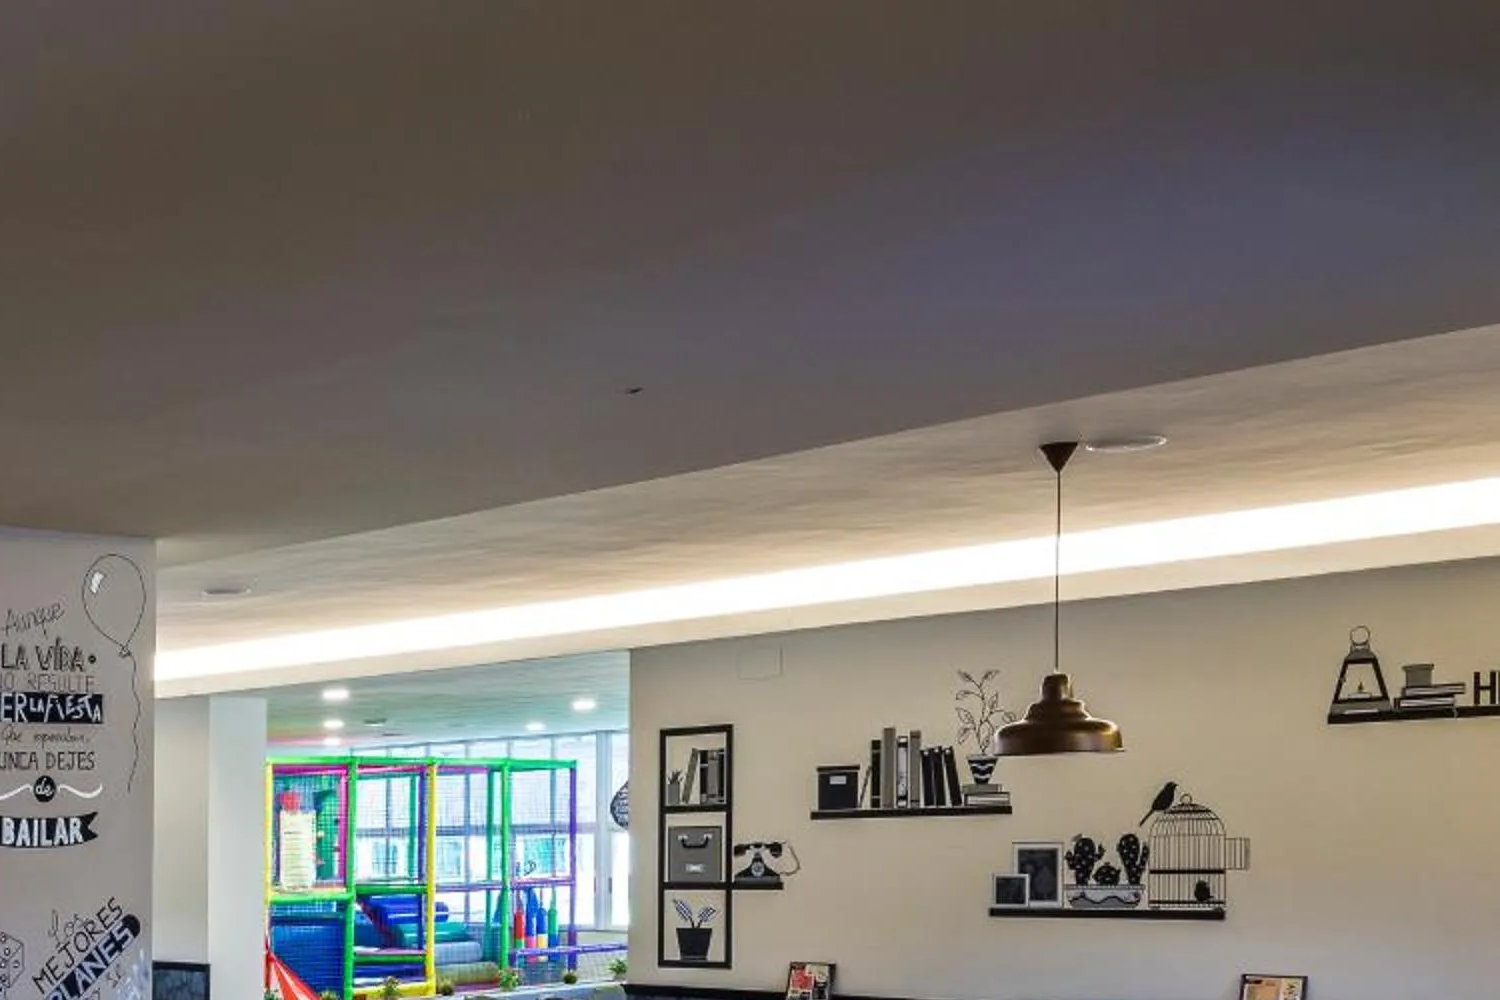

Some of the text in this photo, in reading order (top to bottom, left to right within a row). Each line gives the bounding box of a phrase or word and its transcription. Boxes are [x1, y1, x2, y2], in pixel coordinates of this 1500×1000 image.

[1, 602, 65, 639] Aunque
[1, 643, 29, 671] LA
[46, 752, 96, 771] DEJES
[35, 778, 54, 797] de
[1, 817, 85, 847] BAILAR
[31, 896, 124, 995] MEJORES
